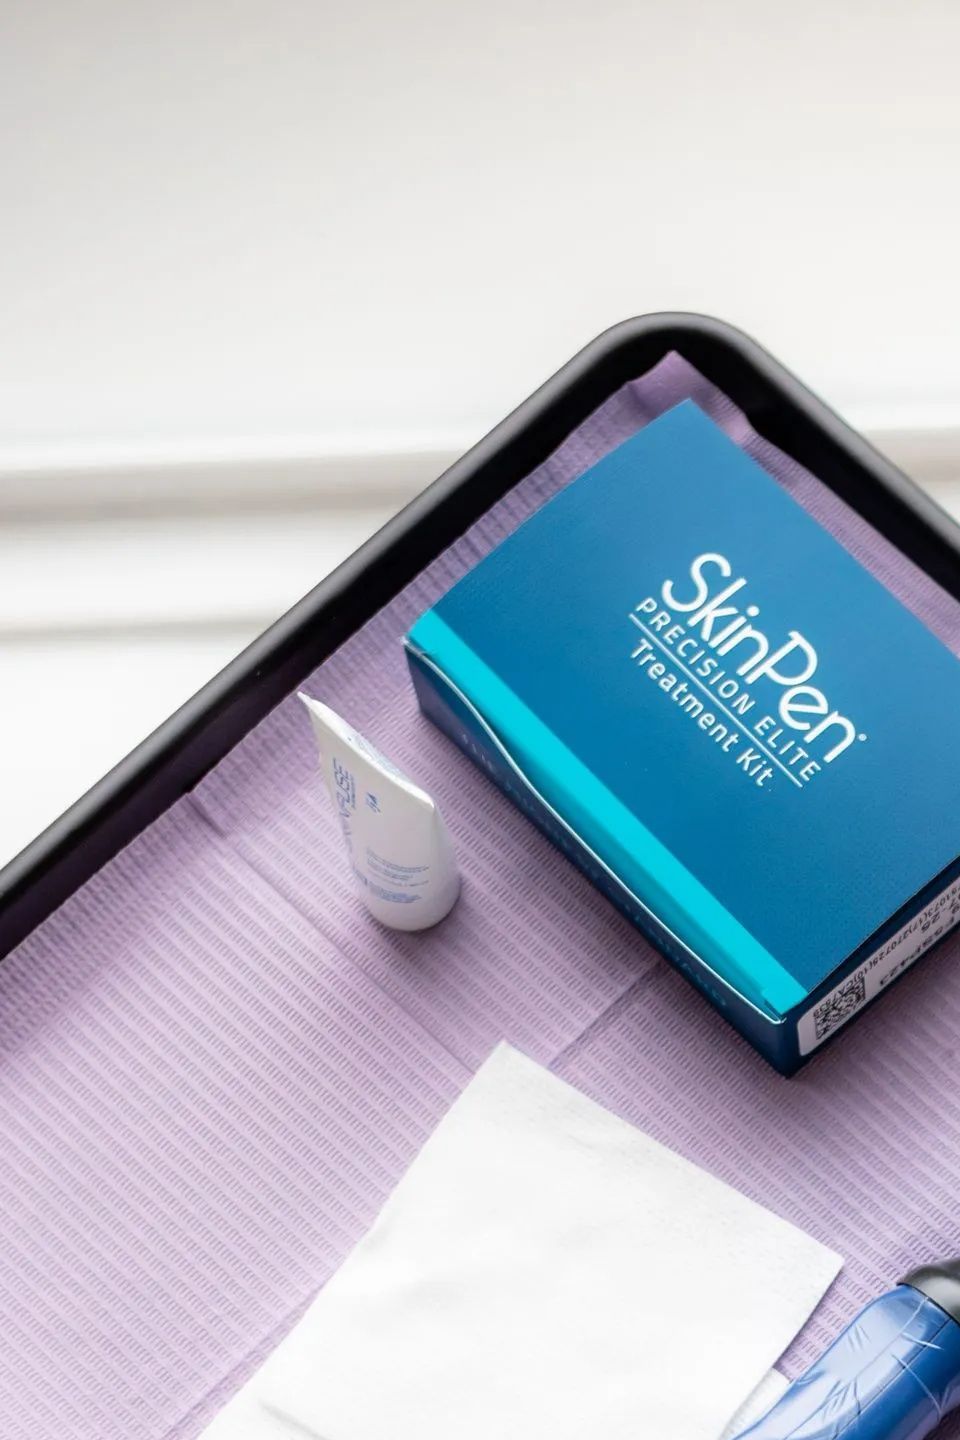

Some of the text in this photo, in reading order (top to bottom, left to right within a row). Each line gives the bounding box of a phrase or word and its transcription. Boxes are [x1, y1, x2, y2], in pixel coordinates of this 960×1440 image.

[630, 638, 774, 787] Treatment Kit
[635, 597, 822, 782] PRECISION ELITE
